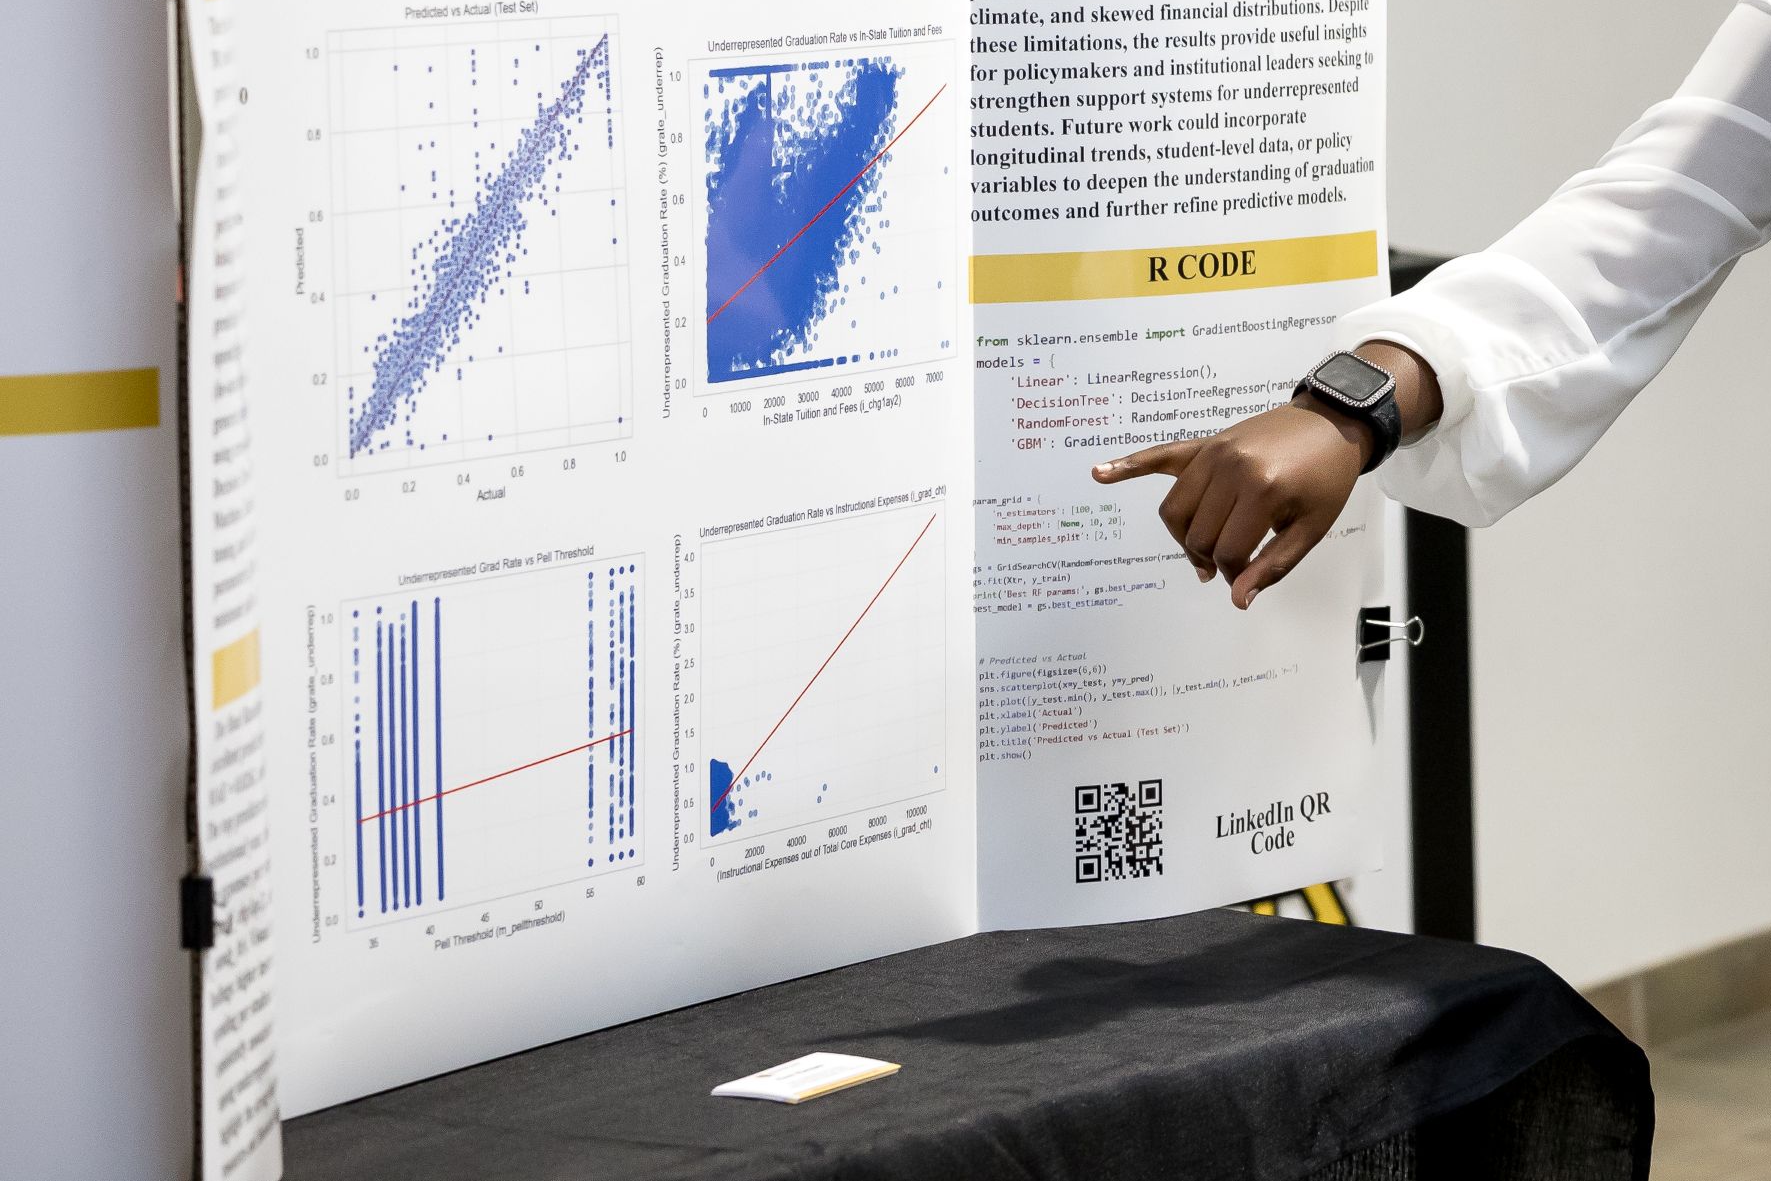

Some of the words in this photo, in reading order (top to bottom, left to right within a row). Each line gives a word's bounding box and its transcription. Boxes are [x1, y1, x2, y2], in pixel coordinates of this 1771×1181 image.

[405, 7, 448, 19] Predicted
[451, 7, 461, 16] vs
[464, 4, 492, 16] Actual
[494, 2, 516, 16] (Test
[519, 0, 539, 14] Set)
[708, 37, 782, 52] Underrepresented
[786, 35, 827, 46] Graduation
[830, 32, 847, 43] Rate
[849, 33, 857, 41] vs
[860, 29, 887, 41] In-State
[889, 28, 911, 38] Tuition
[914, 26, 925, 36] and
[928, 25, 942, 35] Fees
[971, 146, 1084, 169] longitudinal
[1091, 144, 1151, 163] trends,
[1157, 138, 1254, 159] student-level
[1259, 137, 1293, 153] data,
[1298, 139, 1312, 150] or
[1317, 132, 1350, 154] policy
[971, 176, 1056, 194] variables
[1063, 176, 1080, 191] to
[1087, 174, 1147, 194] deepen
[1154, 171, 1179, 187] the
[1185, 164, 1290, 185] understanding
[1295, 162, 1309, 178] of
[1312, 157, 1373, 181] graduation
[971, 206, 1059, 222] outcomes
[1066, 201, 1099, 219] and
[1107, 200, 1168, 217] further
[1174, 196, 1218, 213] refine
[1223, 191, 1293, 215] predictive
[1298, 186, 1346, 205] models.
[1148, 257, 1169, 282] R
[1178, 250, 1256, 280] CODE
[977, 336, 1008, 347] from
[1018, 330, 1137, 346] sklearn.ensemble
[1146, 328, 1185, 341] import
[1193, 316, 1336, 336] GradientBoostingRegressor
[764, 412, 793, 425] In-State
[796, 409, 820, 420] Tuition
[823, 404, 837, 416] and
[840, 403, 857, 414] Fees
[477, 486, 505, 500] Actual
[399, 564, 476, 585] Underrepresented
[480, 561, 500, 573] Grad
[503, 558, 522, 568] Rate
[525, 557, 534, 565] vs
[537, 552, 552, 563] Pell
[554, 546, 594, 560] Threshold
[990, 655, 1037, 665] Predicted
[1057, 652, 1086, 661] Actual
[1216, 801, 1294, 838] LinkedIn
[1300, 792, 1331, 822] QR
[1251, 826, 1294, 854] Code
[435, 938, 450, 950] Pell
[453, 928, 493, 945] Threshold
